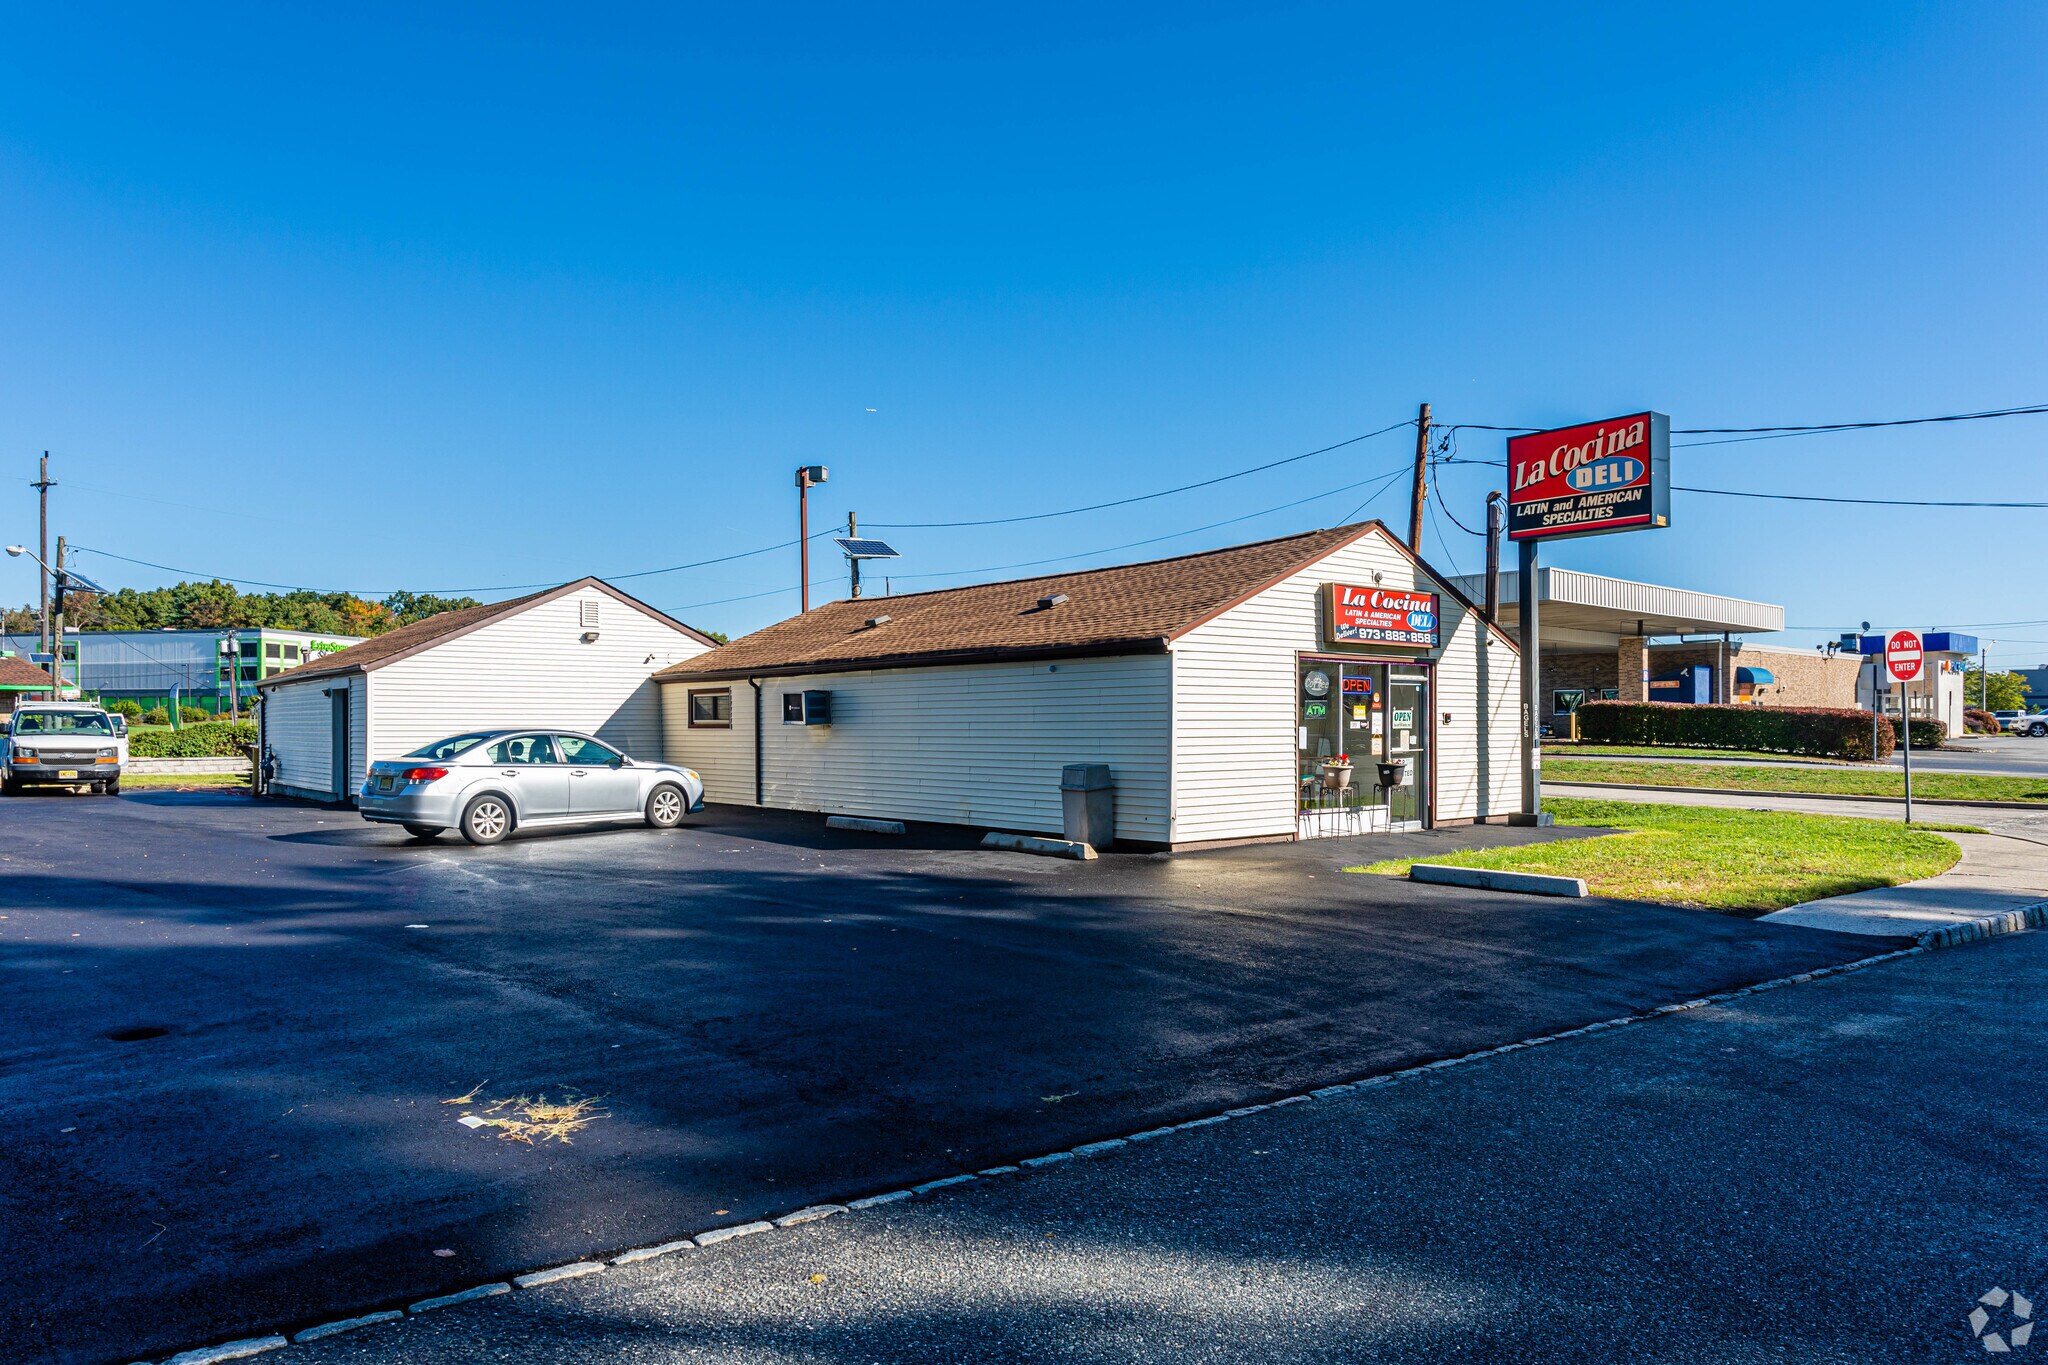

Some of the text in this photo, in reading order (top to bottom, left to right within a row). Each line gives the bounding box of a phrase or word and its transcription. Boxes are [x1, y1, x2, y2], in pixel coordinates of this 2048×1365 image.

[1513, 421, 1645, 492] La Cocina
[1575, 460, 1634, 488] DELI
[1516, 489, 1642, 517] LATIN and AMERICAN
[1542, 506, 1614, 526] SPECIALTIES
[1341, 588, 1431, 613] La Cocina
[1345, 609, 1363, 617] LATIN
[1370, 612, 1401, 620] AMERICAN
[1410, 614, 1433, 628] DELI
[1340, 623, 1350, 631] We
[1355, 618, 1392, 627] SPECIALTIES
[1336, 626, 1358, 640] Deliver!
[1904, 640, 1917, 648] NOT
[1895, 662, 1915, 671] ENTER
[1342, 678, 1370, 692] OPEN
[1306, 705, 1326, 716] ATM
[1394, 712, 1411, 722] OPEN
